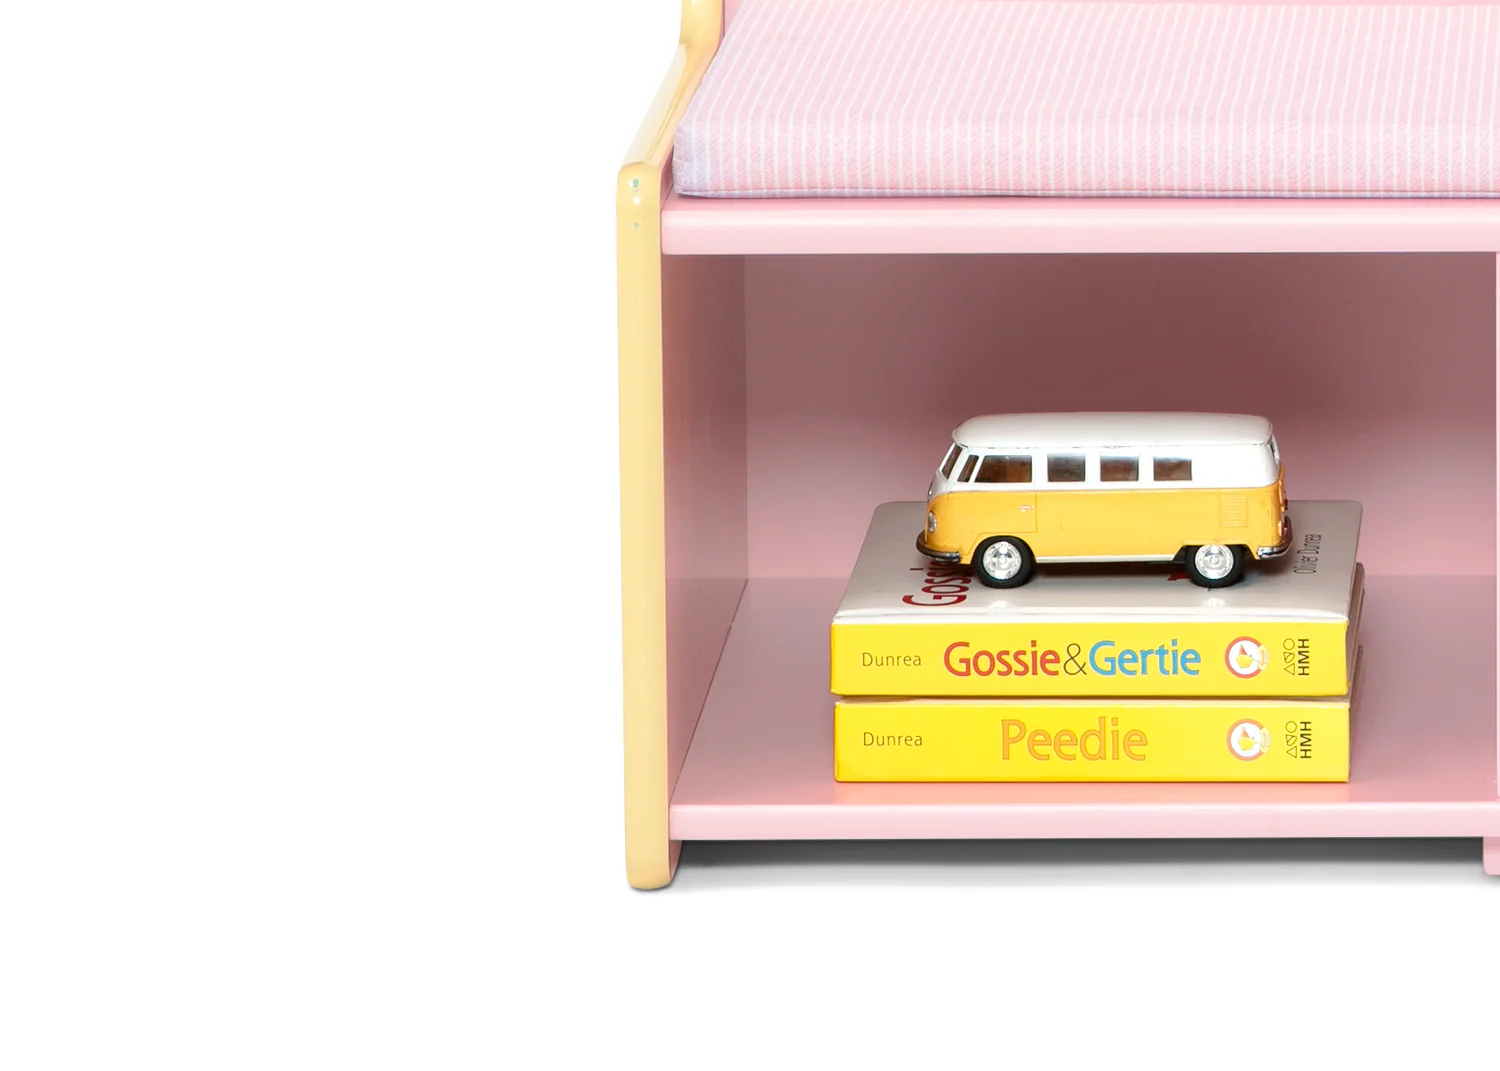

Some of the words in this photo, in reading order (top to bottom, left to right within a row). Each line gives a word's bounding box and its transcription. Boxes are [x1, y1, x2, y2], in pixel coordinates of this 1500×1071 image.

[861, 651, 922, 668] Dunrea
[1297, 638, 1310, 676] HMH
[863, 731, 923, 748] Dunrea
[1001, 716, 1148, 762] Peedie
[1300, 721, 1312, 759] HMH
